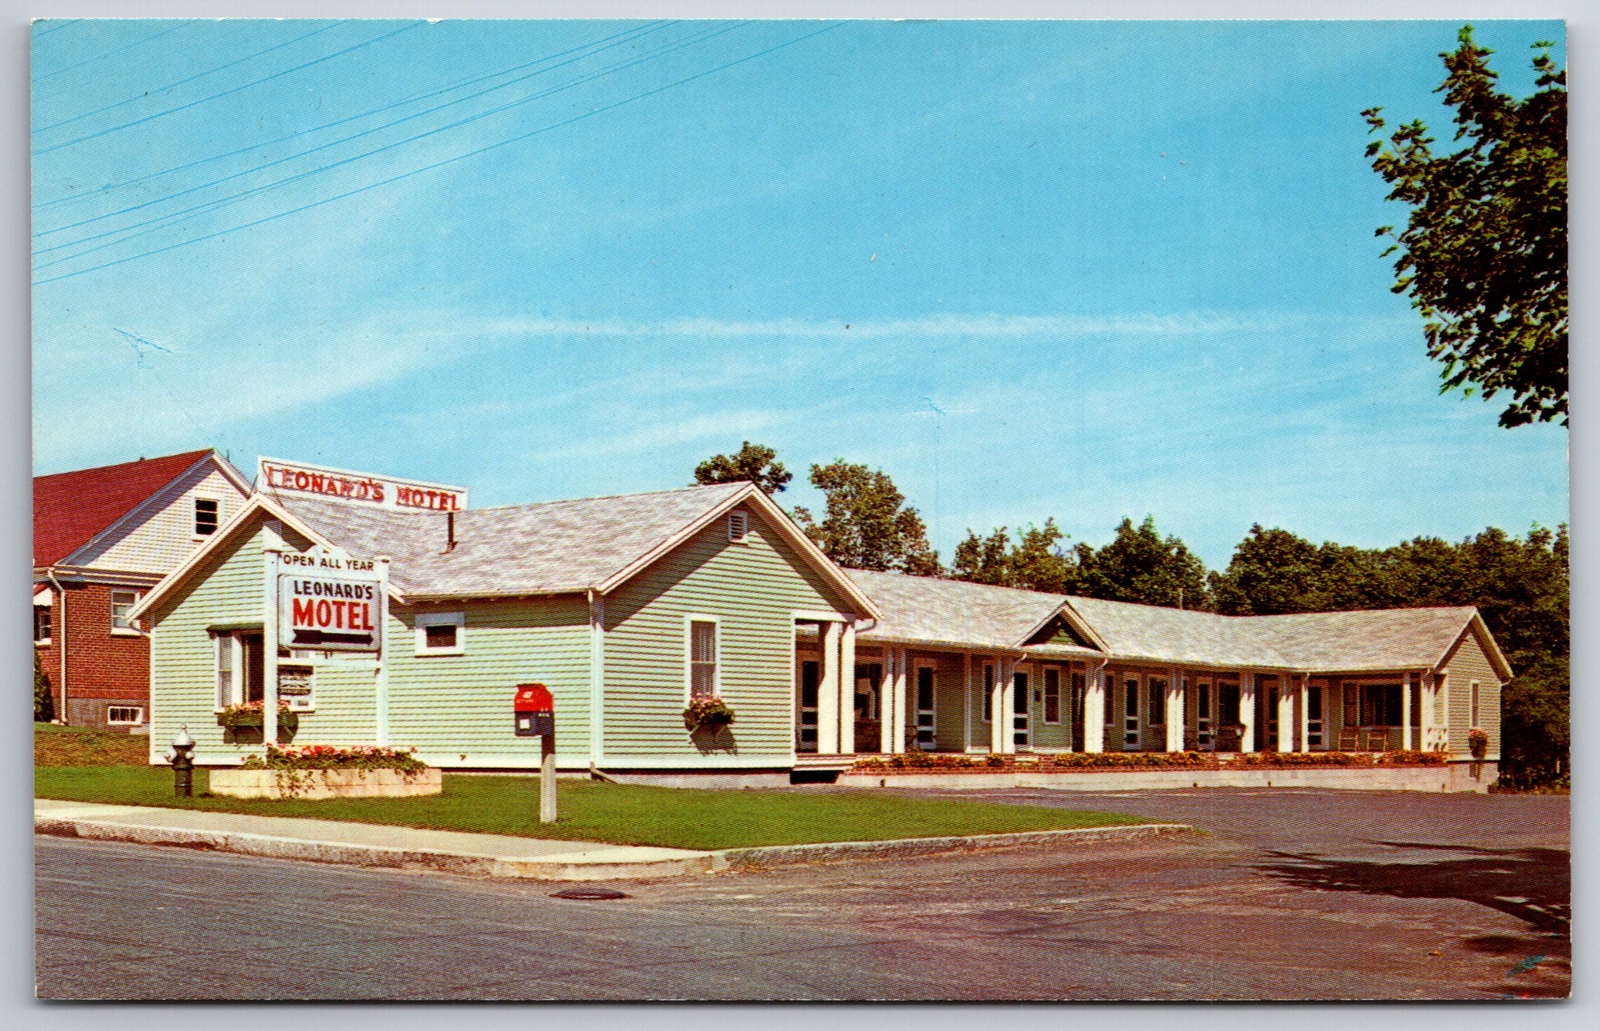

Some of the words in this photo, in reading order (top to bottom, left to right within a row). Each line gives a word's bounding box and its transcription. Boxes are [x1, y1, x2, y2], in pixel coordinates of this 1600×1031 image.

[267, 466, 385, 503] LEONARD'S
[396, 486, 461, 511] MOTEL
[283, 554, 315, 566] OPEN
[320, 558, 342, 569] ALL
[345, 560, 374, 571] YEAR
[294, 580, 373, 600] LEONARD'S
[292, 598, 375, 631] MOTEL
